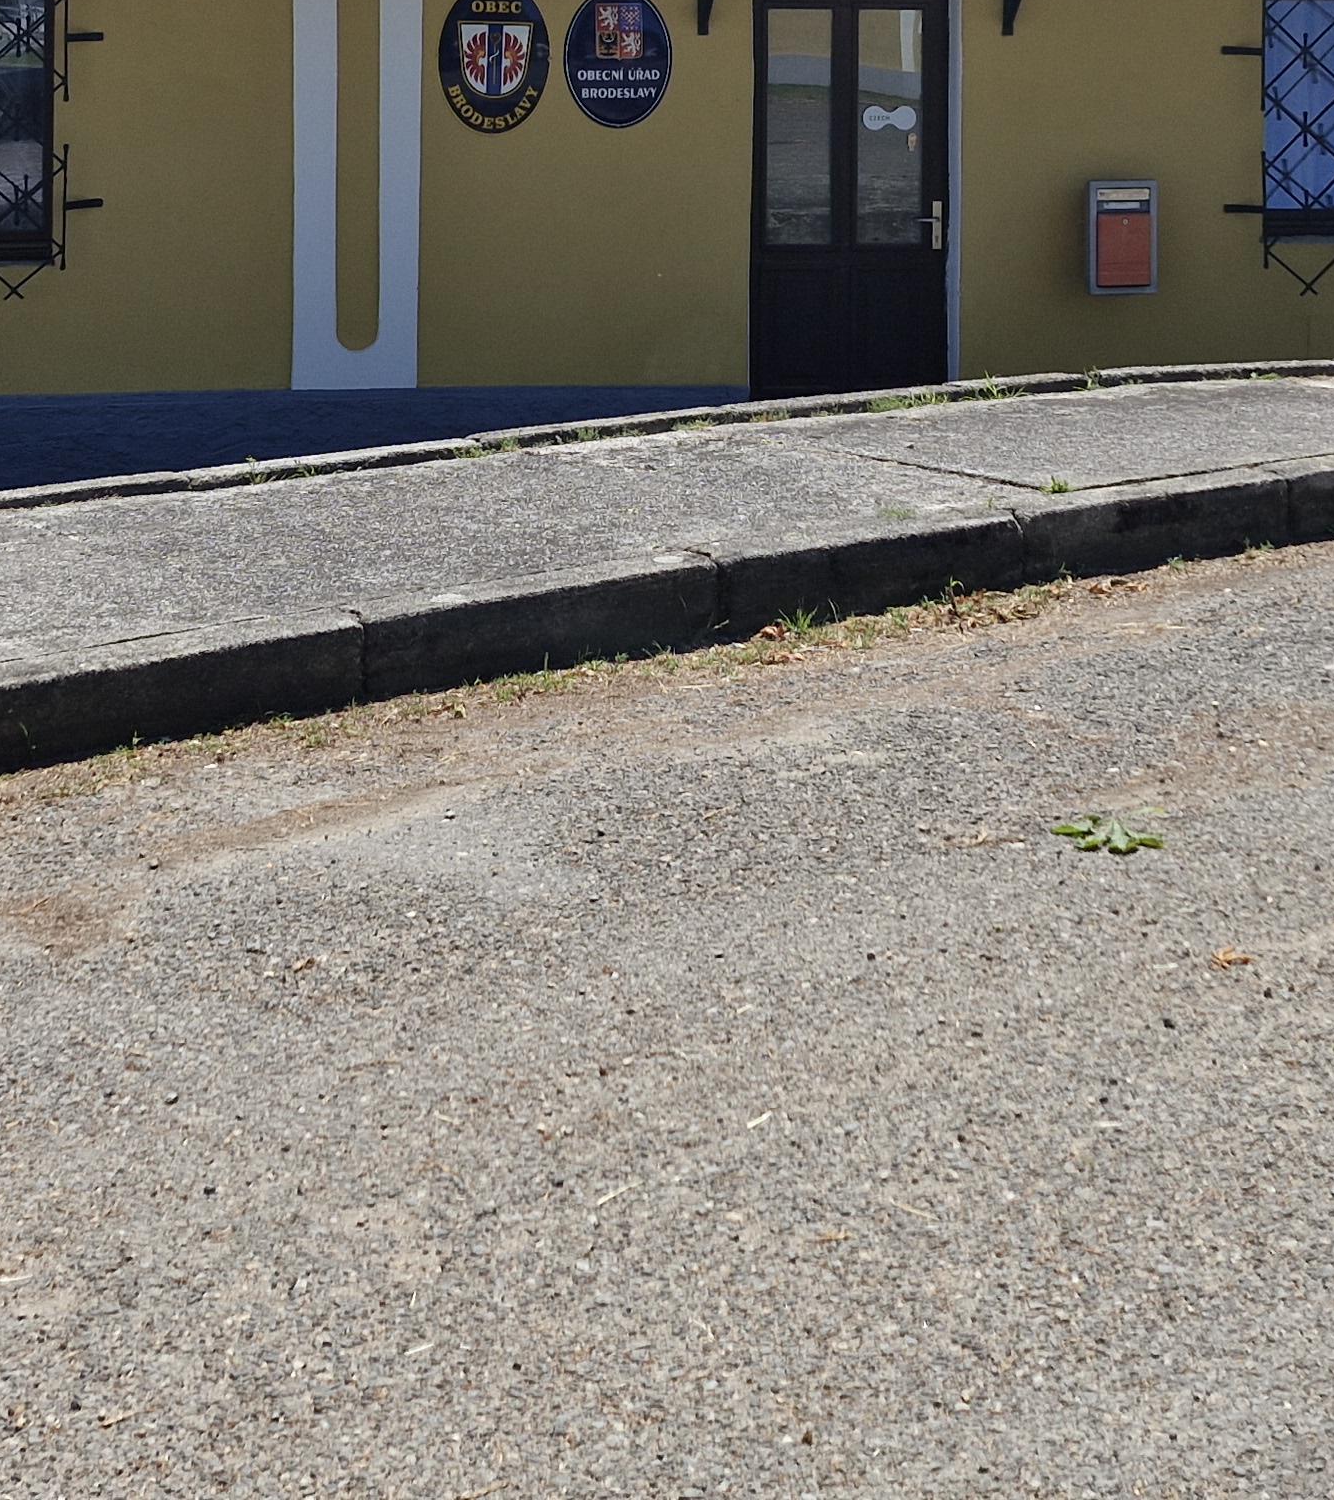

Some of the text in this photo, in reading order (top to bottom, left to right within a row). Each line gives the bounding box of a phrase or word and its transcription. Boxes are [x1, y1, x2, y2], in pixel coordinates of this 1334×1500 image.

[471, 0, 522, 14] OBEC
[577, 67, 660, 80] OBECNÍ ÚŘAD
[581, 87, 657, 99] BRODESLAVY
[448, 84, 538, 129] BRODESLAVY
